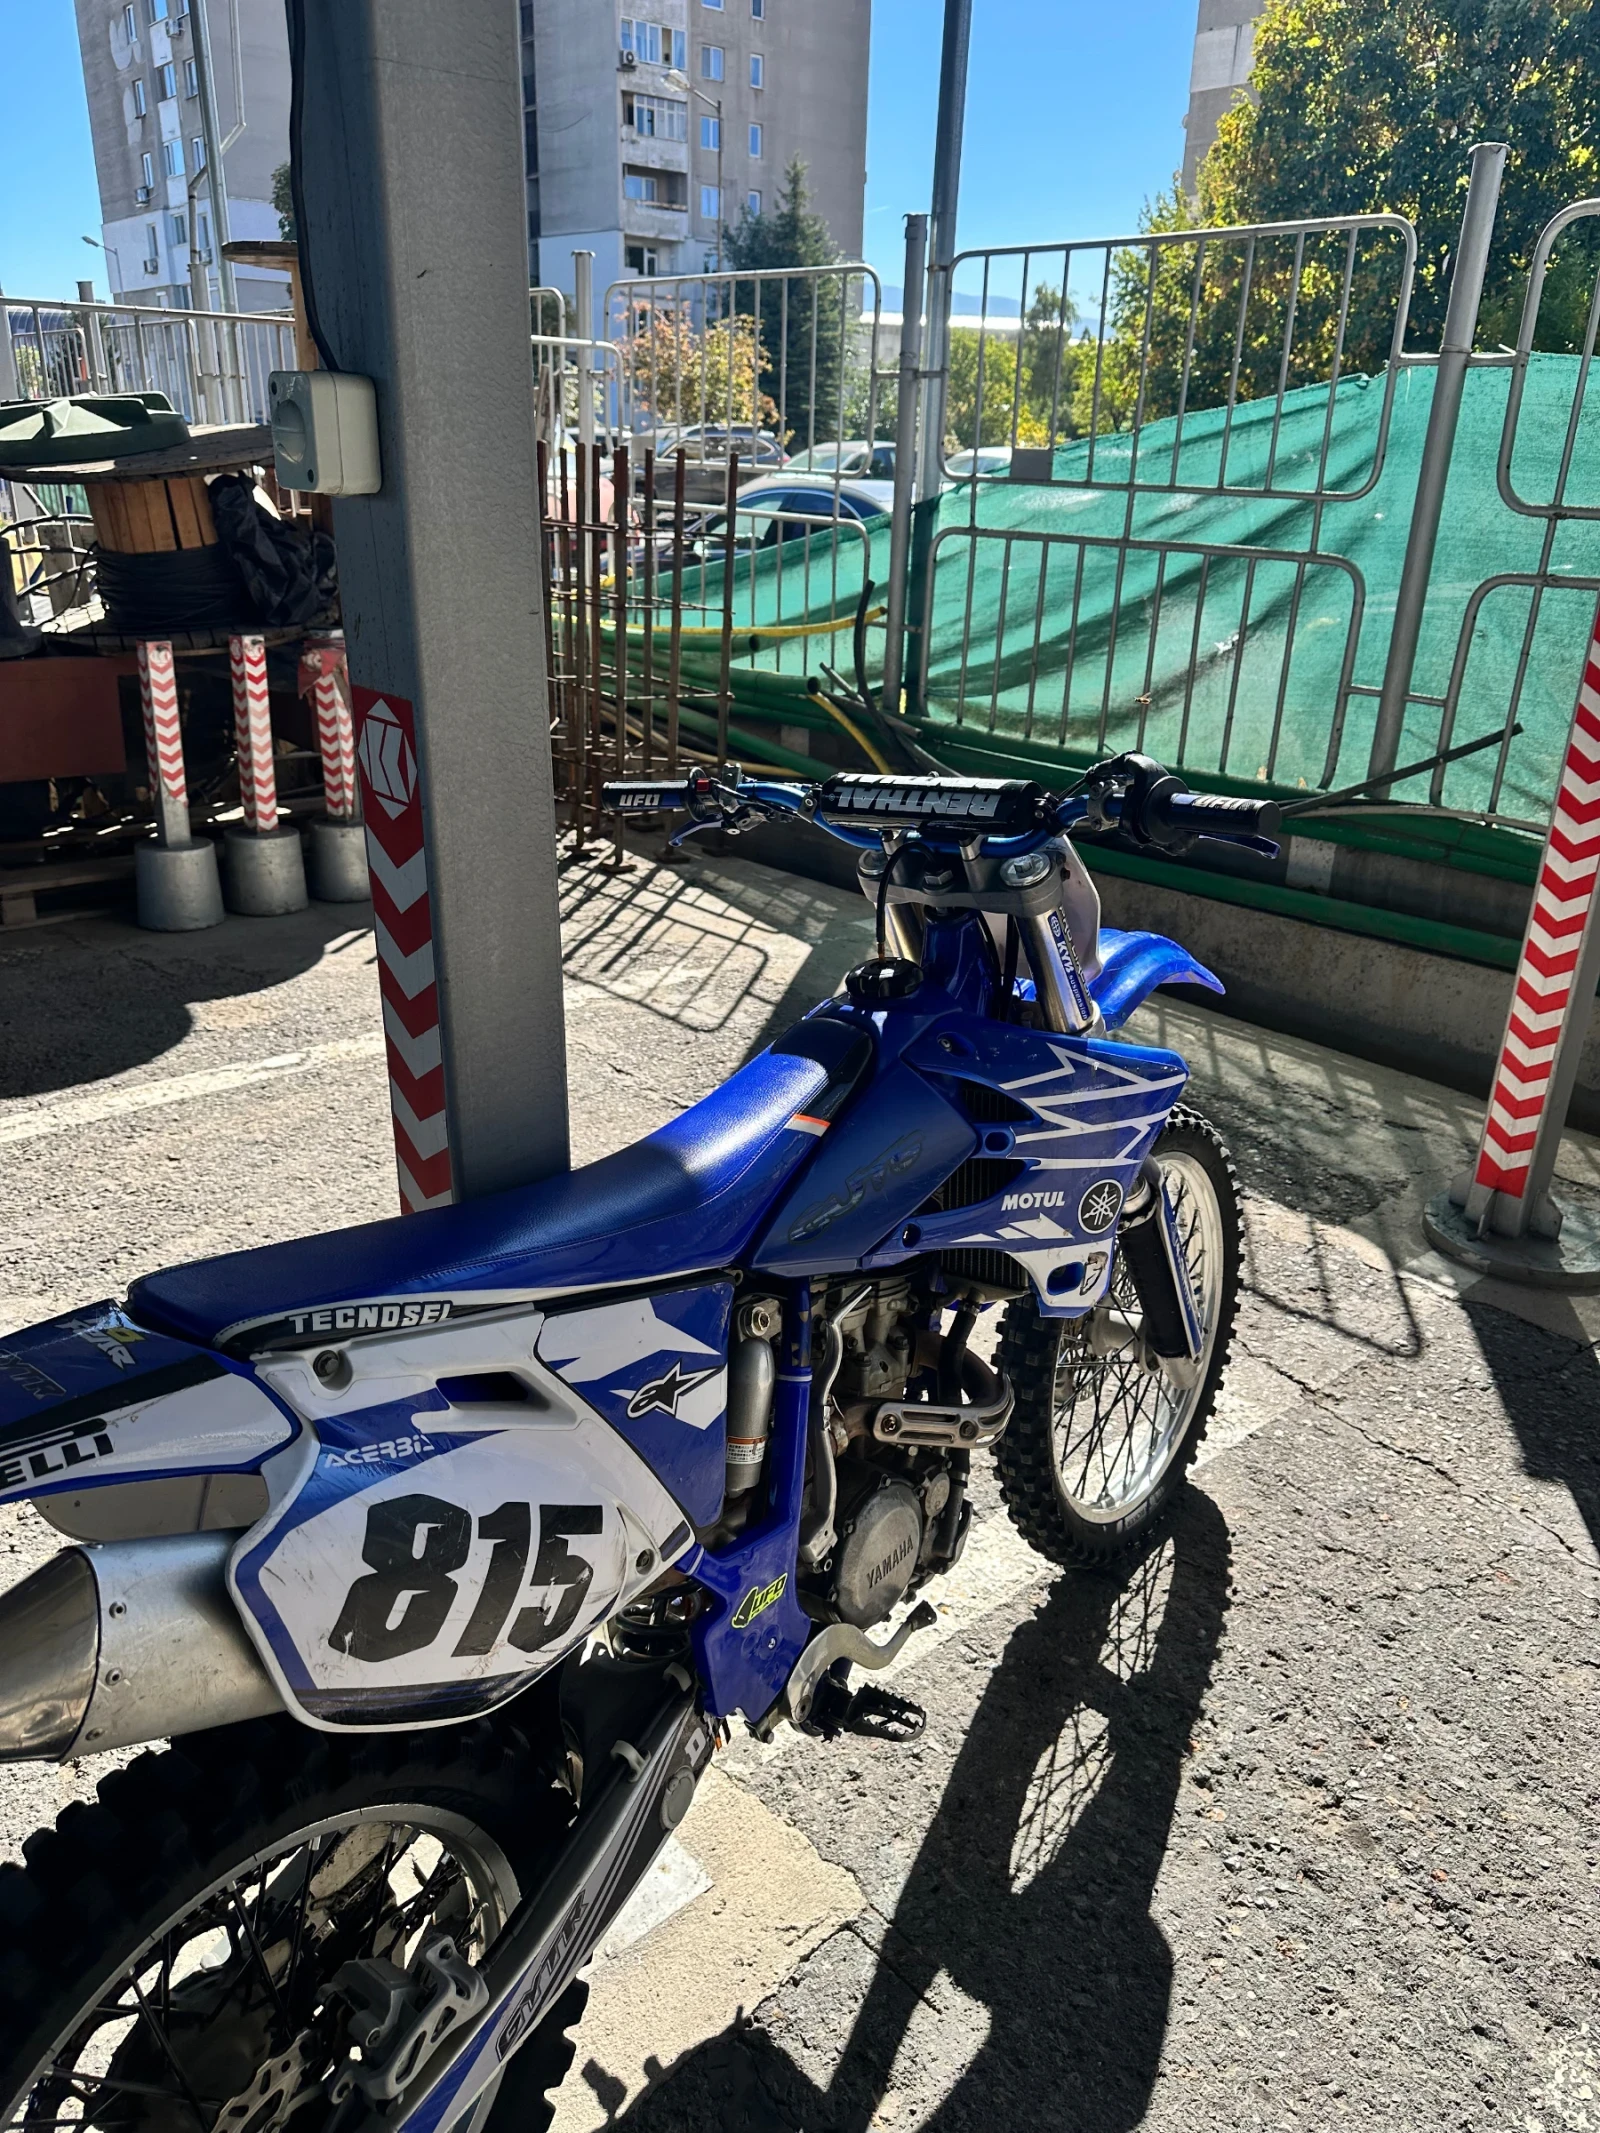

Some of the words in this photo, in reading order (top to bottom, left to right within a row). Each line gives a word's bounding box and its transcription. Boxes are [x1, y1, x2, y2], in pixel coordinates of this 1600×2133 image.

[619, 793, 660, 807] UFO
[833, 786, 1002, 818] RENTHAL
[1056, 940, 1075, 973] KYB
[1068, 974, 1089, 1021] suspension
[1001, 1191, 1065, 1211] MOTUL
[328, 1493, 603, 1662] 815
[866, 1535, 914, 1589] YAMAHA
[753, 1576, 787, 1611] UFO
[495, 1889, 589, 2063] GYTR
